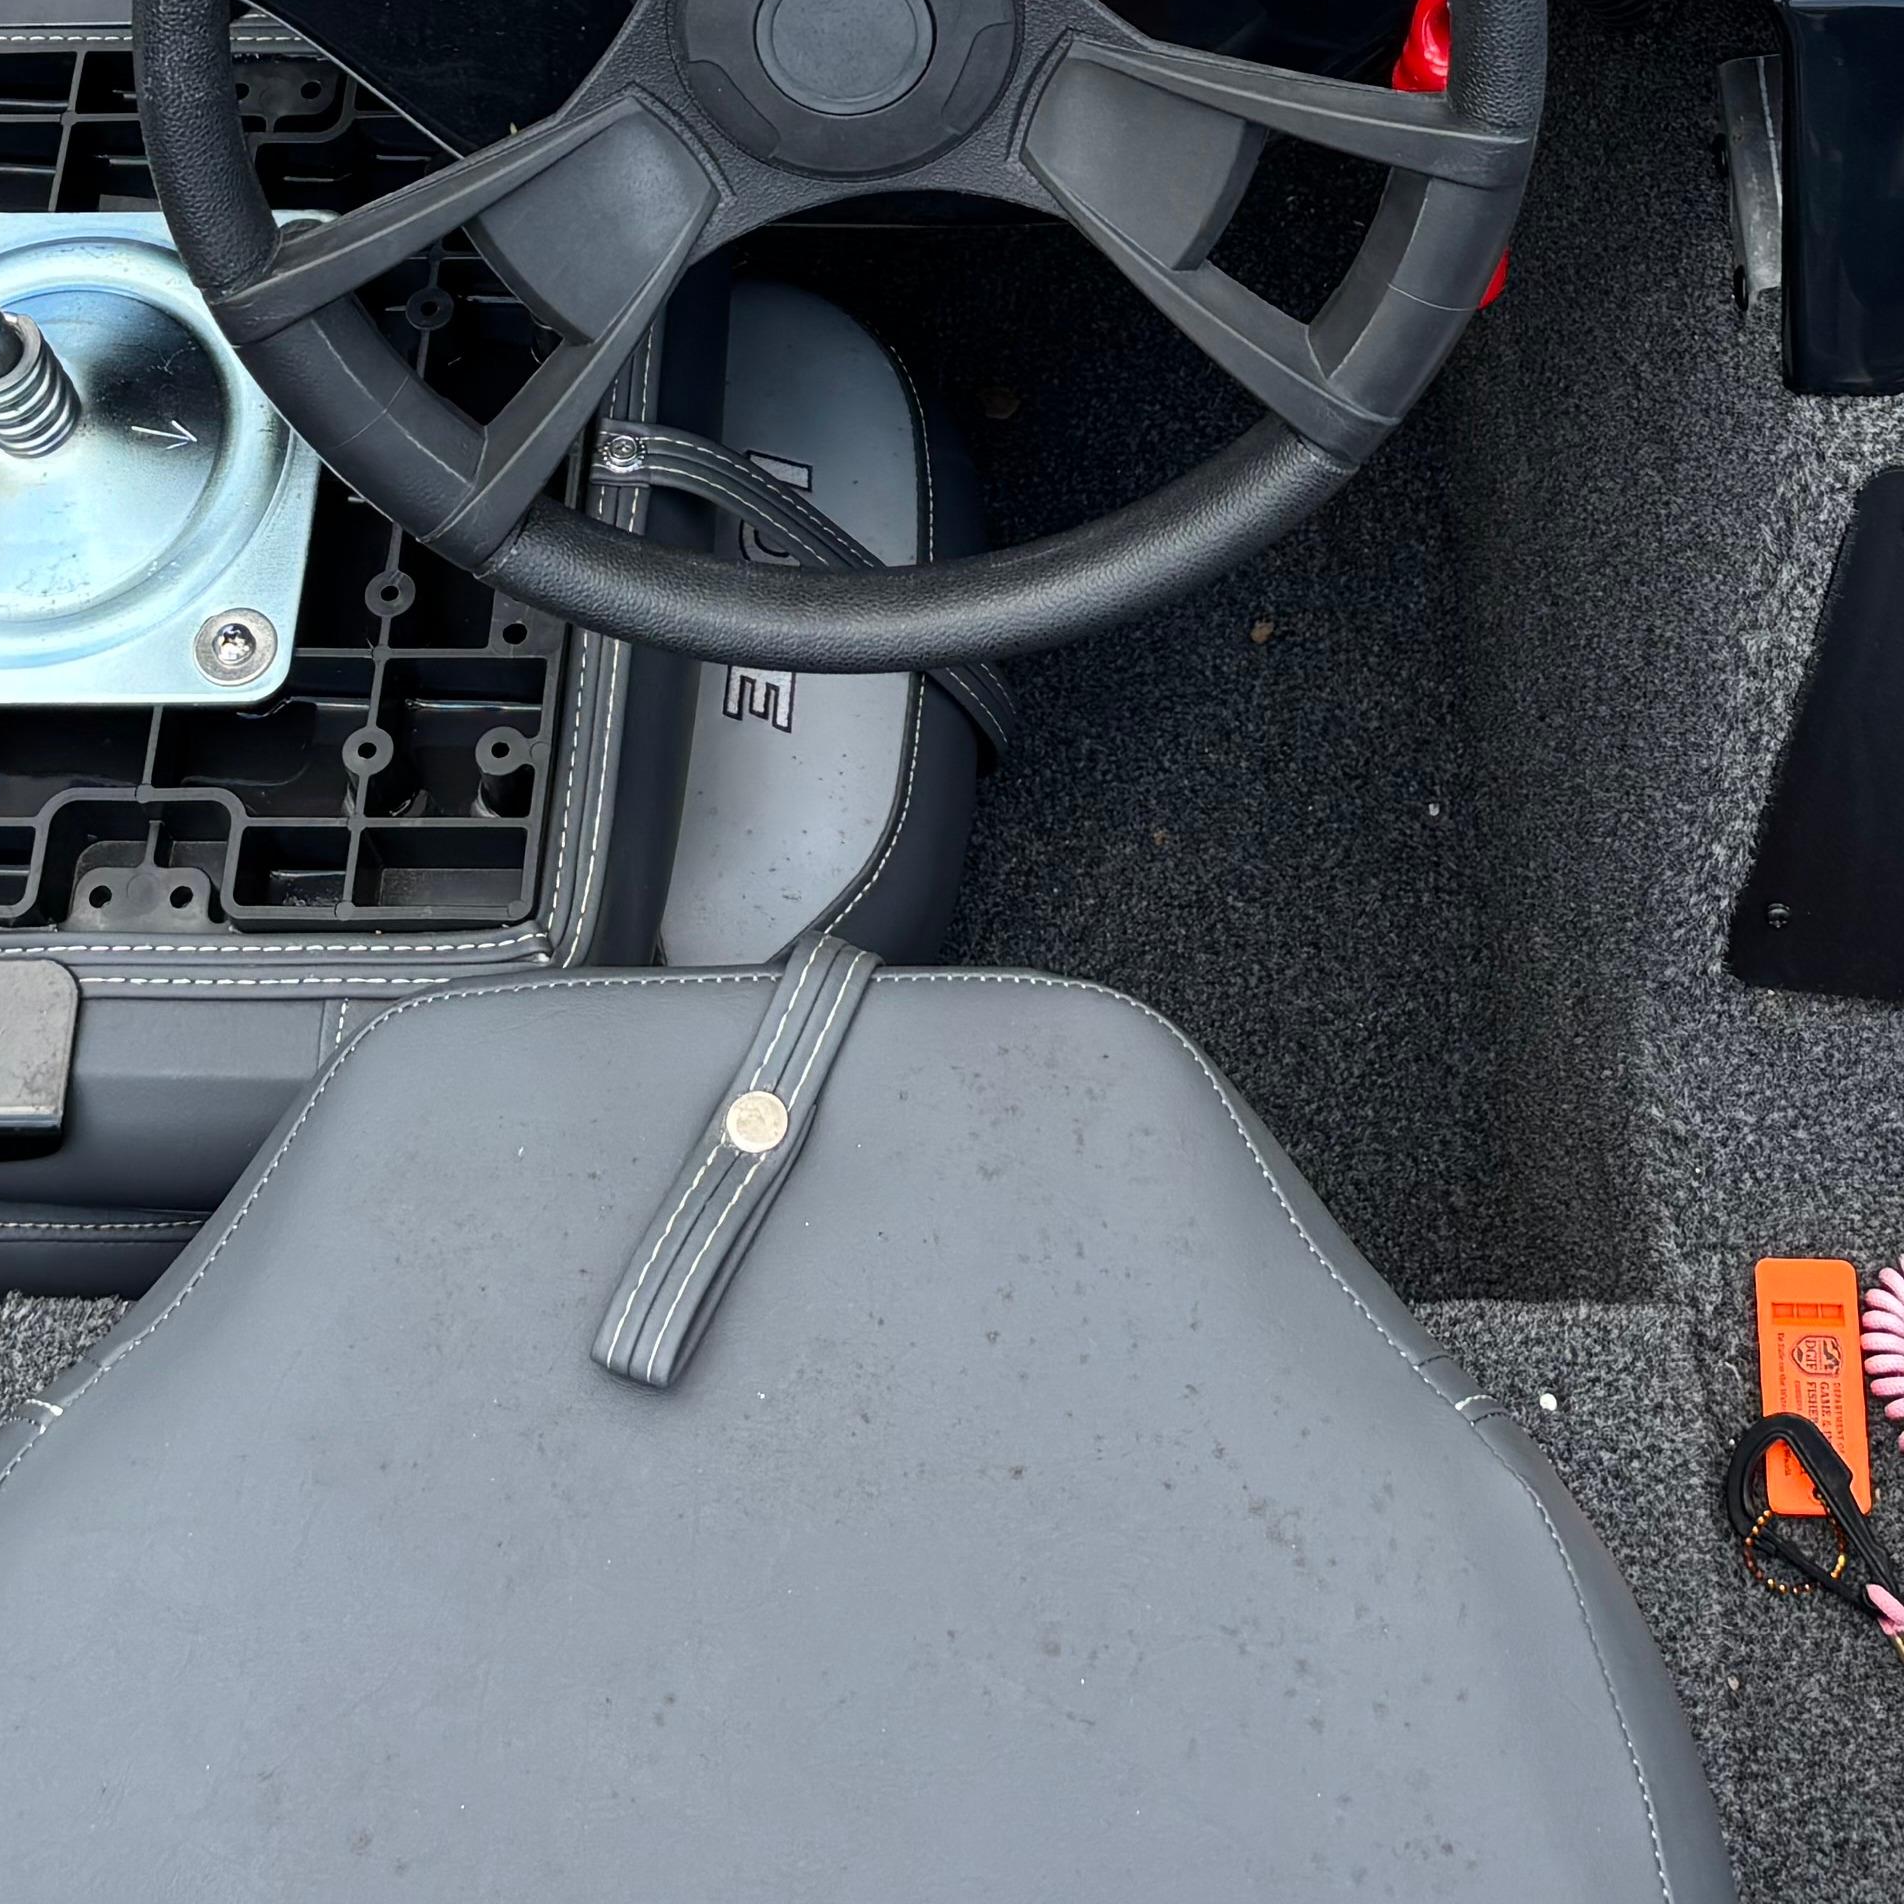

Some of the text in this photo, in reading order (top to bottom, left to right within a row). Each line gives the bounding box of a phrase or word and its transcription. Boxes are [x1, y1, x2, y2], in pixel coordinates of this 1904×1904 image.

[1803, 1338, 1818, 1371] DGIF
[1818, 1380, 1831, 1417] GAME
[1832, 1382, 1844, 1440] DEPARTMENT
